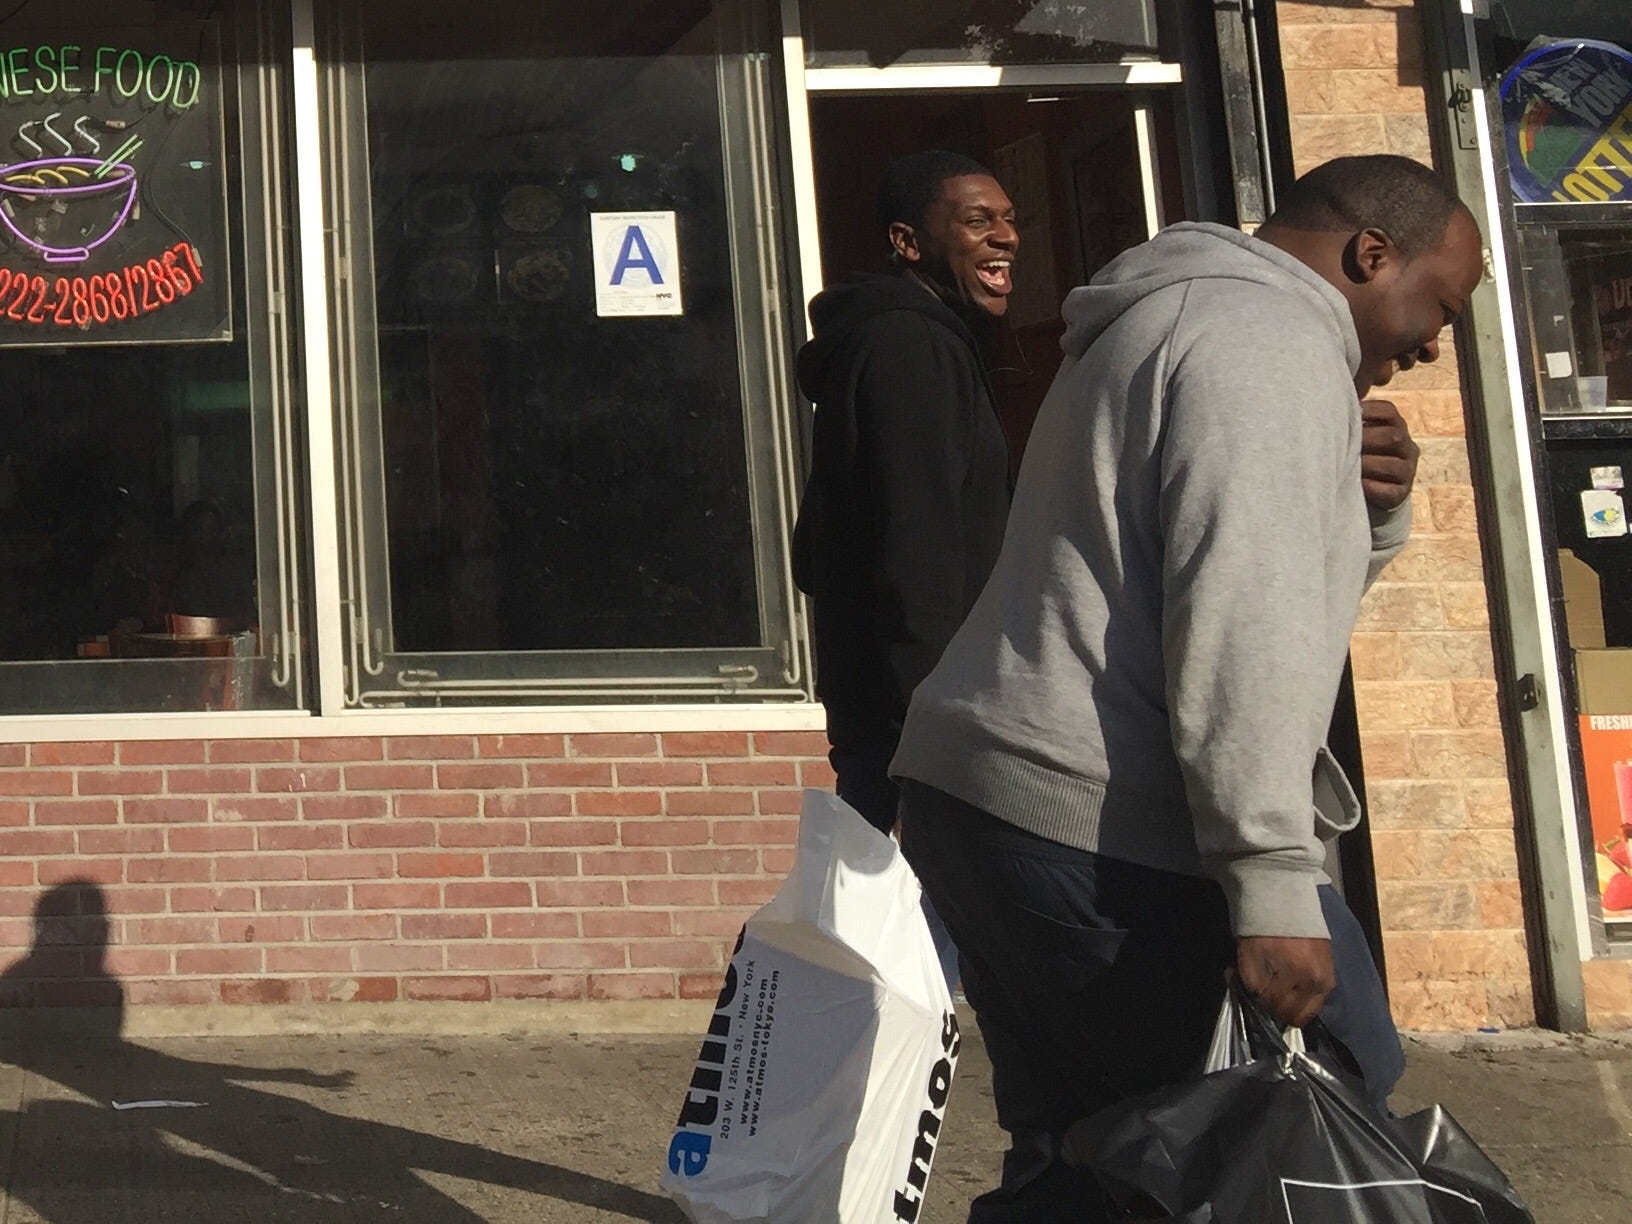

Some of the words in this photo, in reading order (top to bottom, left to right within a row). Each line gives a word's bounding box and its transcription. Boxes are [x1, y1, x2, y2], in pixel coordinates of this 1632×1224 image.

[94, 47, 200, 109] FOOD
[609, 225, 664, 286] A
[742, 960, 755, 988] York
[739, 992, 750, 1020] New
[728, 1056, 741, 1090] 125th
[741, 978, 768, 1125] www.atmosnyc.com
[749, 970, 779, 1137] www.atmos-tokyo.com
[720, 1117, 732, 1139] 203
